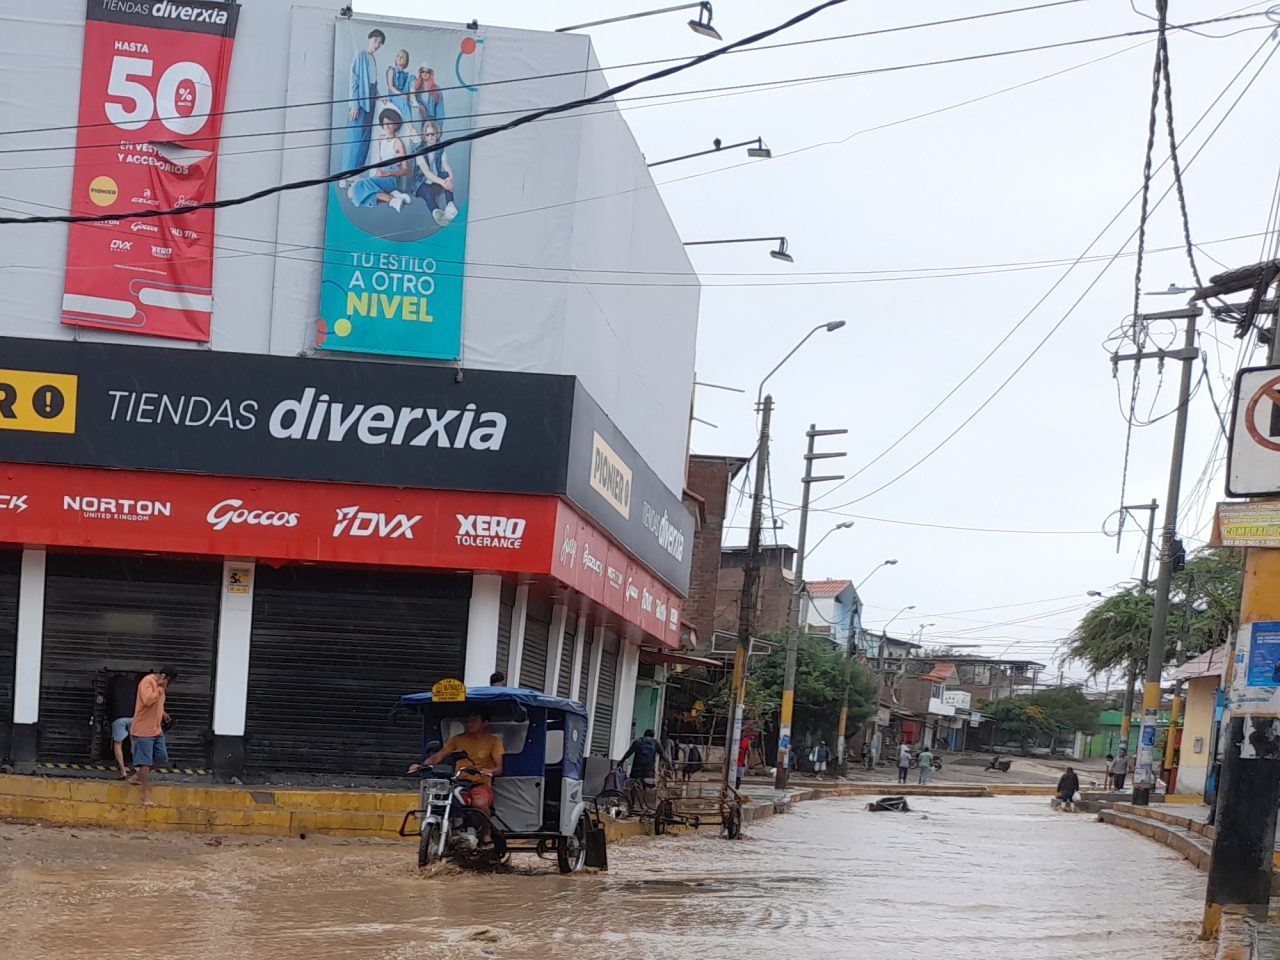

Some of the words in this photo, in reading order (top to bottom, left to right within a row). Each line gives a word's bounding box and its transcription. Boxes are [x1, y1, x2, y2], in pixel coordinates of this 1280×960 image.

[152, 0, 228, 24] diverxia
[114, 40, 149, 53] HASTA
[104, 55, 213, 135] 50
[117, 153, 124, 162] Y
[349, 252, 374, 268] TU
[379, 253, 437, 274] ESTILO
[349, 271, 366, 289] A
[371, 272, 435, 296] OTRO
[346, 292, 433, 323] NIVEL
[108, 390, 258, 431] TIENDAS
[268, 387, 508, 451] diverxia
[63, 495, 171, 516] NORTON
[83, 511, 111, 520] UNITED
[114, 513, 150, 521] KINGDOM
[455, 514, 527, 539] XERO
[455, 535, 523, 549] TOLERANCE
